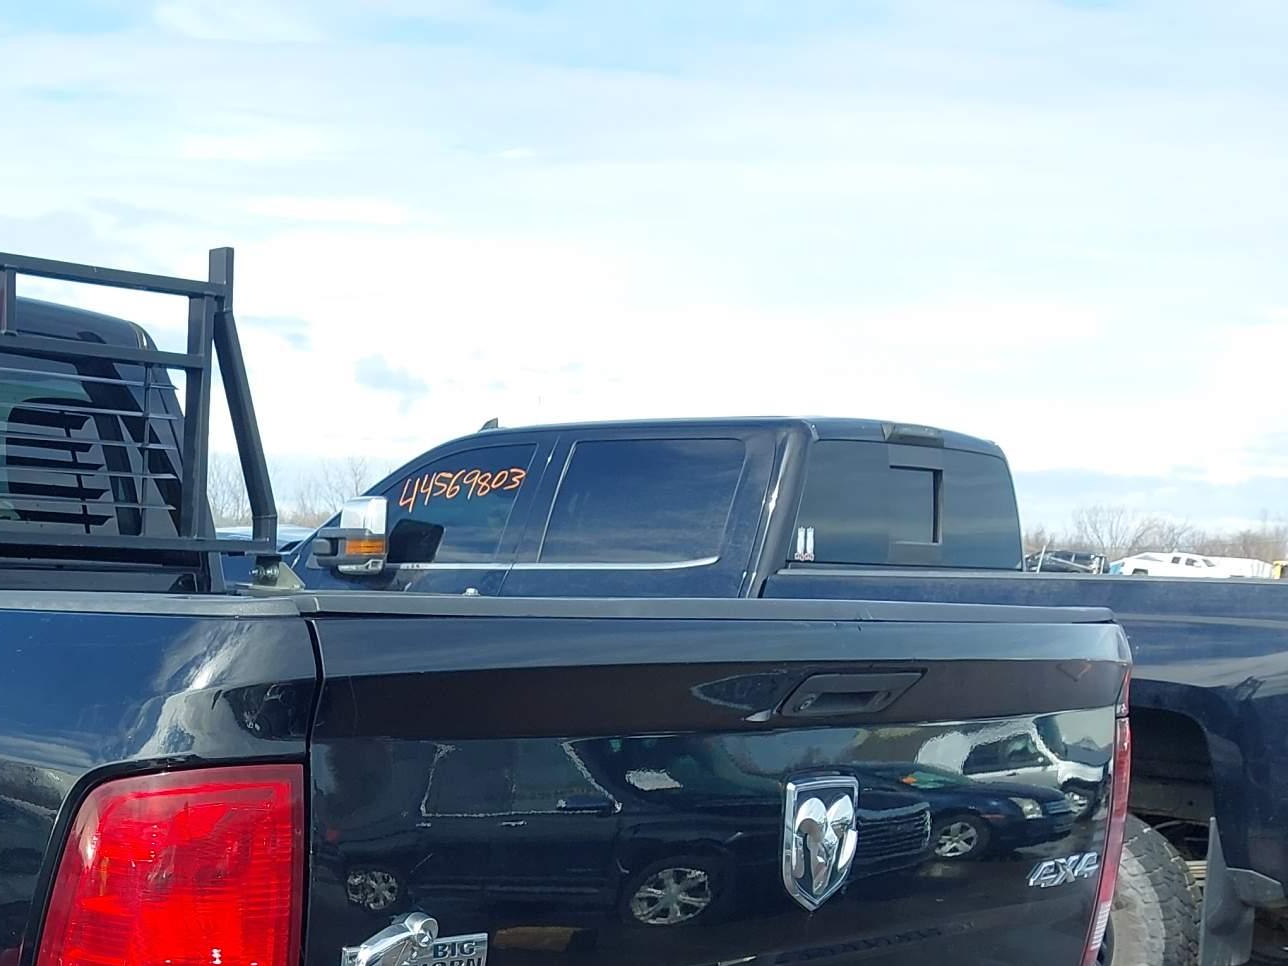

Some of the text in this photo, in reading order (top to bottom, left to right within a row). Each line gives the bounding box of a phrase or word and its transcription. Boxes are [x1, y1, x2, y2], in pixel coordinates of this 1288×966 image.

[398, 468, 527, 513] 44569803
[1027, 851, 1100, 888] 4X4
[432, 941, 478, 960] BIG
